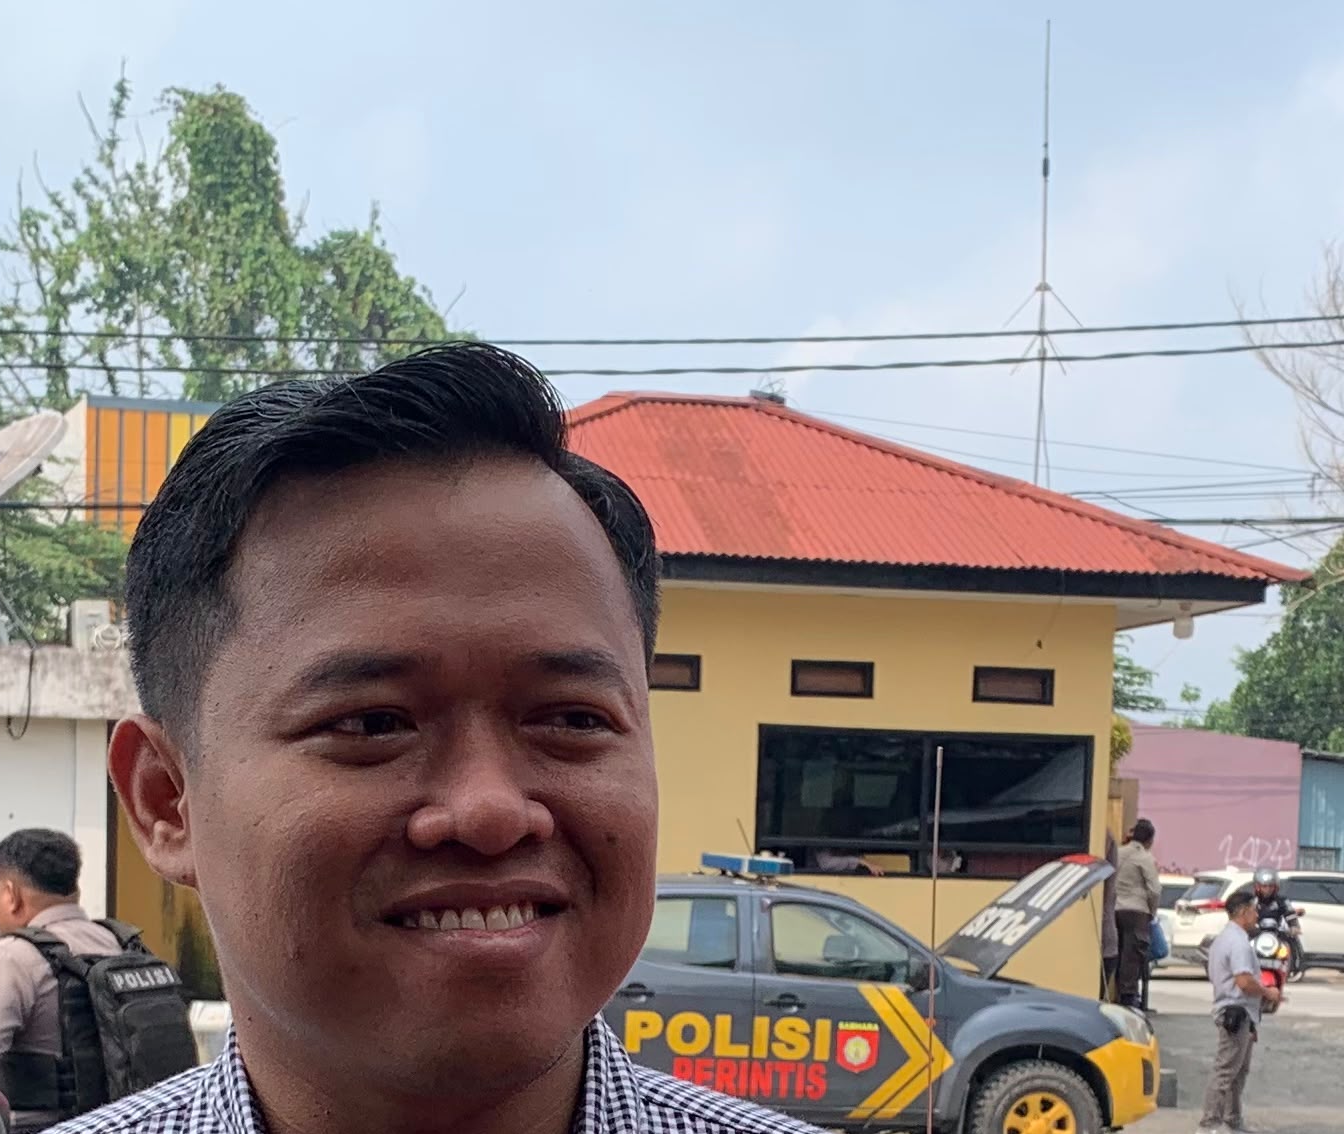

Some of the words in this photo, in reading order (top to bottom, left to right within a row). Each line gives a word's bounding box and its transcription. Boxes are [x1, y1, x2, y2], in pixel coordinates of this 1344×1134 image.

[113, 967, 175, 989] POLISI
[624, 1009, 832, 1062] POLISI
[672, 1057, 828, 1101] PERINTIS
